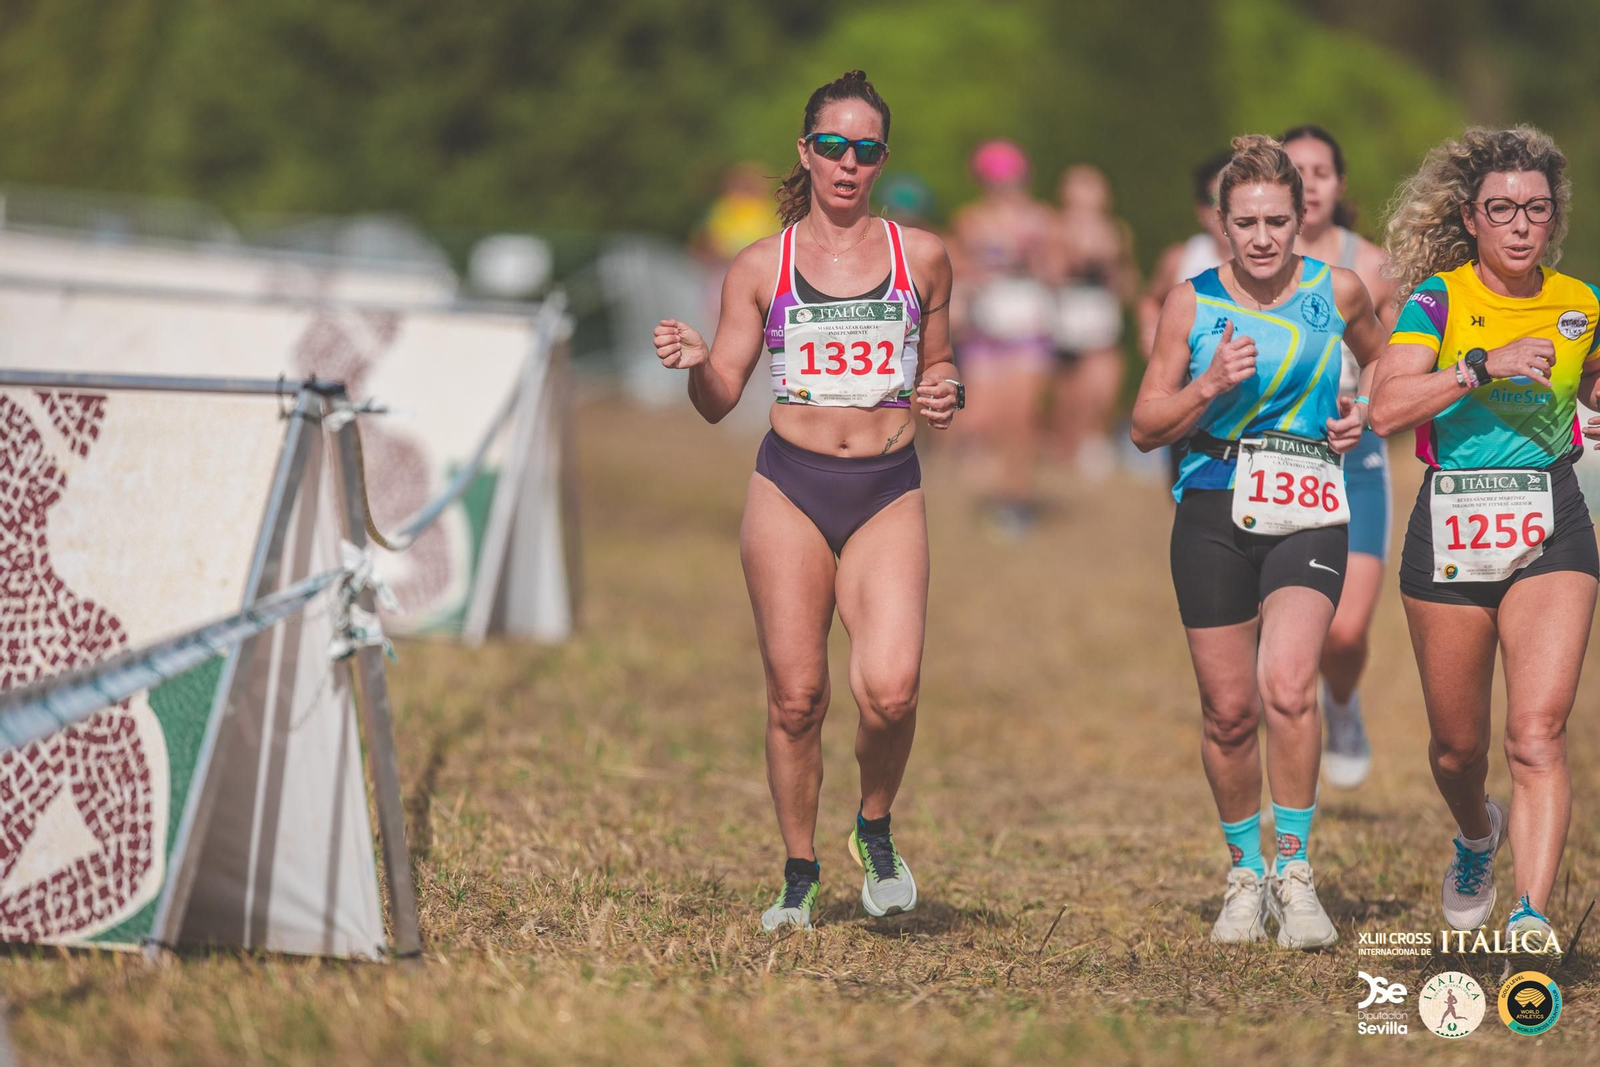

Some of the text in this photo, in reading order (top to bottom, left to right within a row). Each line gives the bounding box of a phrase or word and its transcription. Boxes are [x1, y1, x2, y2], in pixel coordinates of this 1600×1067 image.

[820, 305, 875, 319] ITÁLICA
[800, 341, 896, 376] 1332
[1489, 387, 1553, 404] AireSur
[1248, 469, 1339, 512] 1386
[1461, 474, 1519, 490] ITÁLICA
[1445, 512, 1545, 550] 1256
